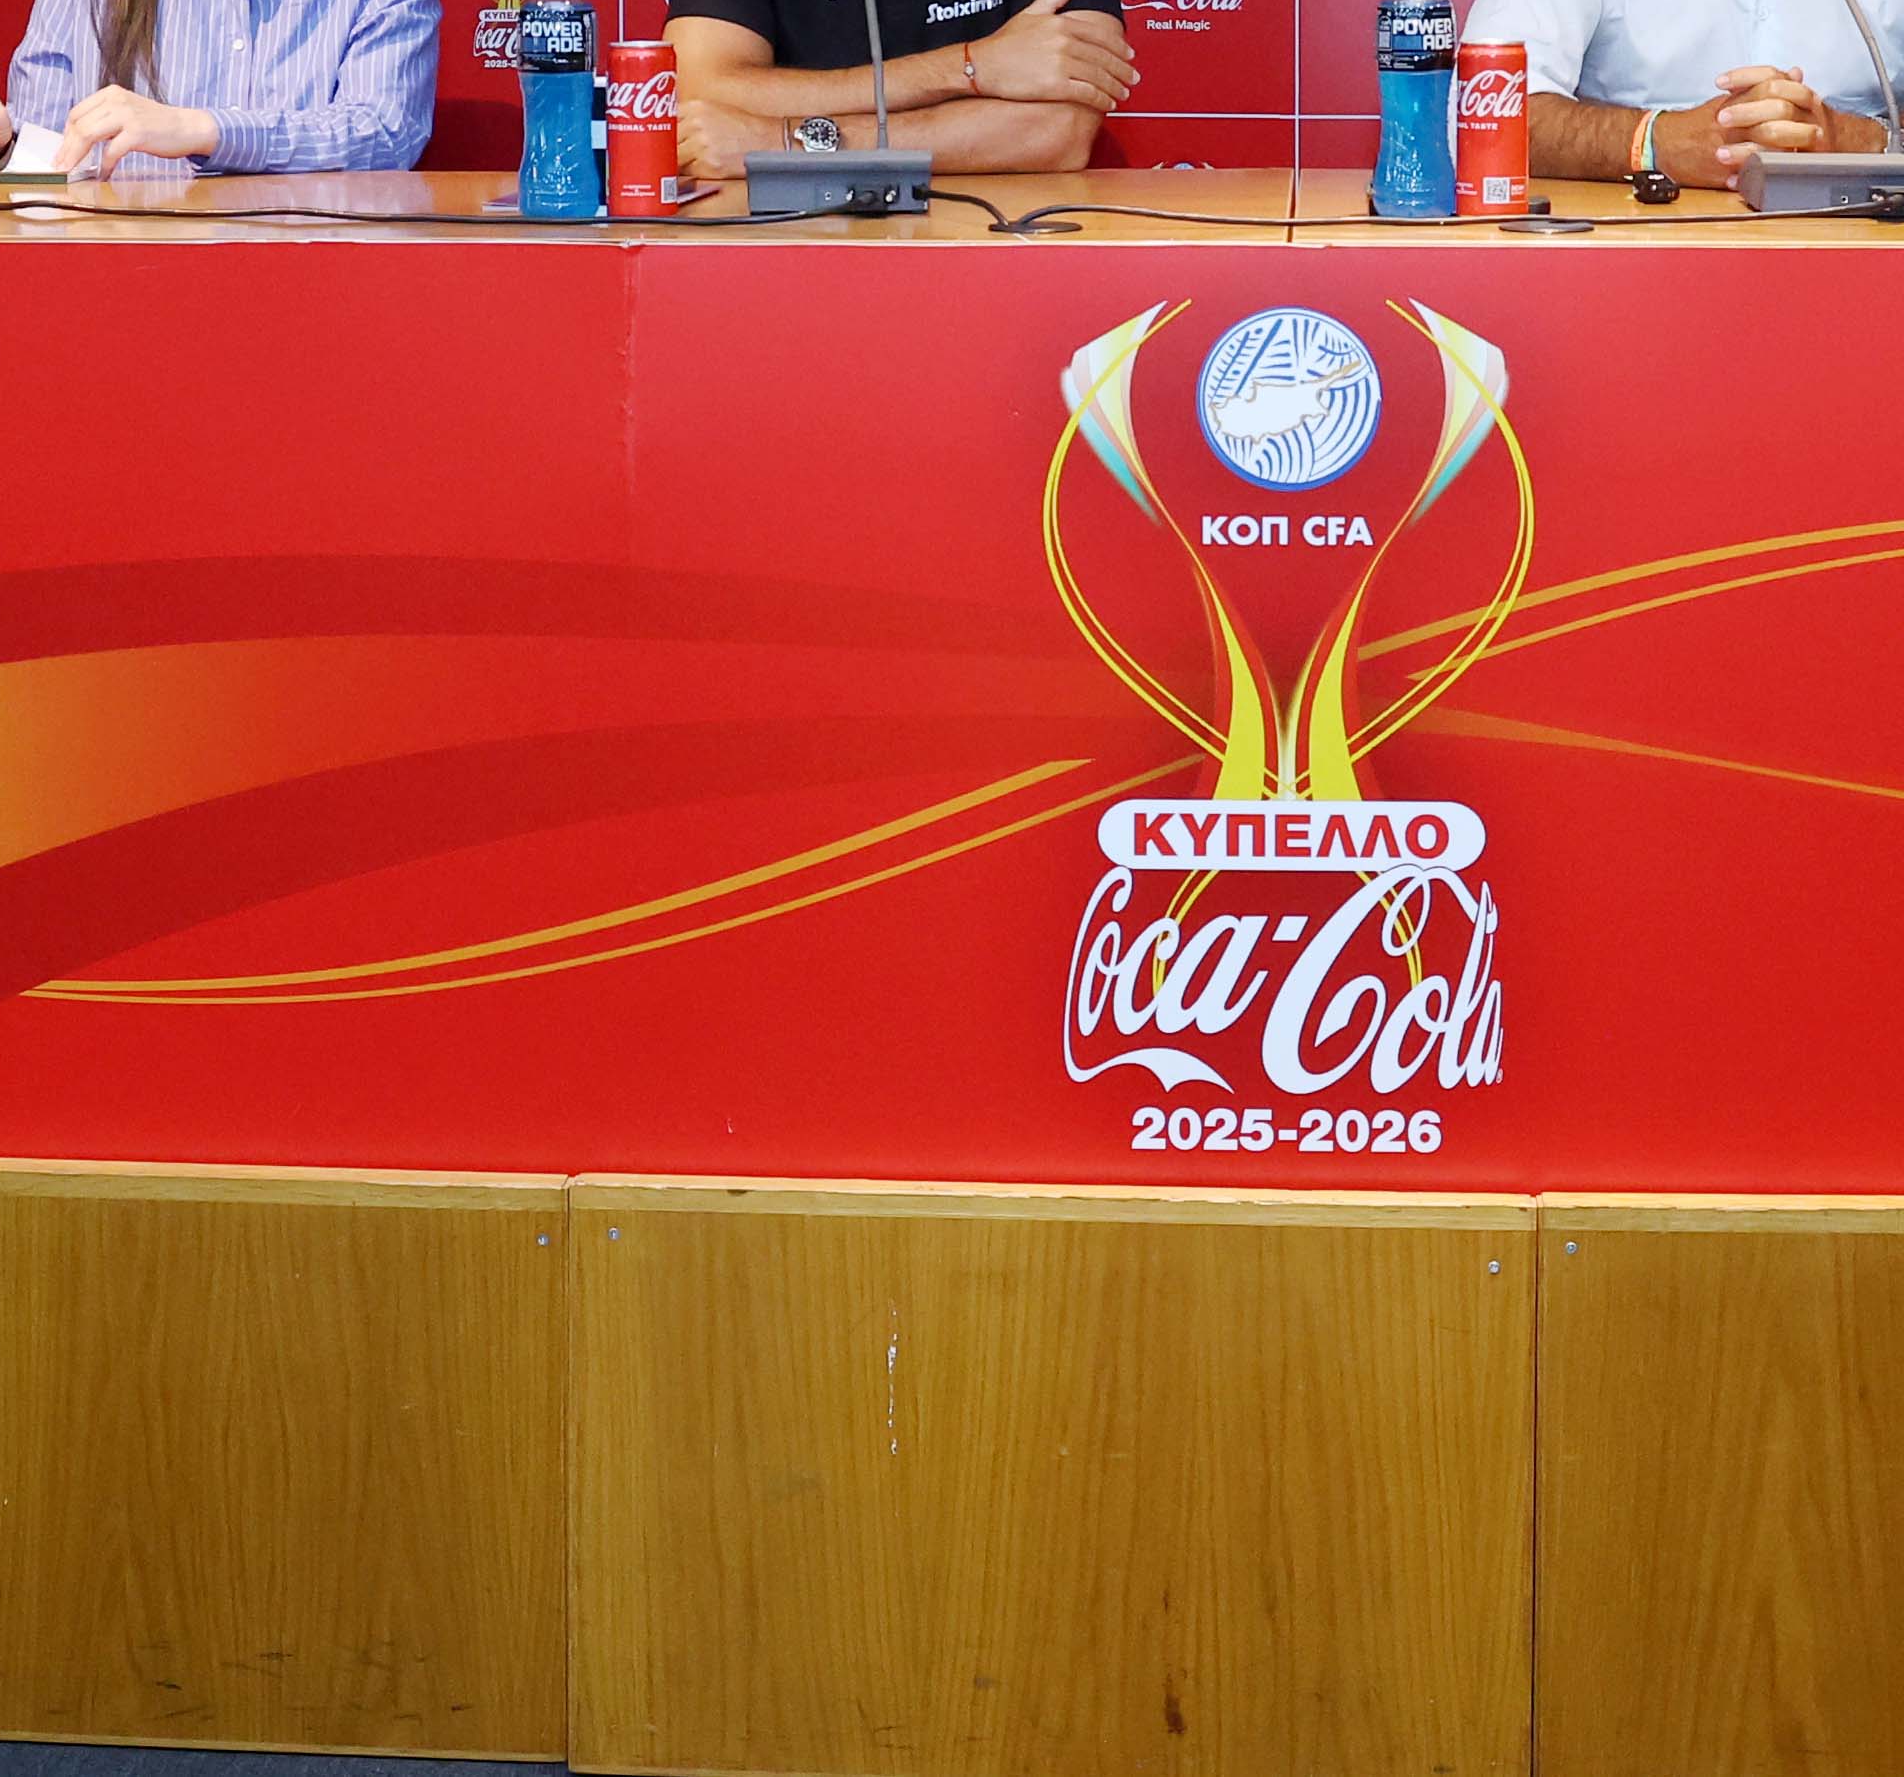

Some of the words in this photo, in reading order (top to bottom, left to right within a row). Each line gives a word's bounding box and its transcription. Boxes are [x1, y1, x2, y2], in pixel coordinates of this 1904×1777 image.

[522, 21, 583, 37] POWER
[1147, 20, 1173, 32] Real
[1176, 20, 1211, 34] Magic
[1393, 19, 1454, 36] POWER
[546, 37, 583, 53] ADE
[1423, 35, 1454, 51] ADE
[1470, 122, 1498, 131] TASTE
[1201, 515, 1289, 546] ΚΟΠ
[1302, 515, 1374, 546] CFA
[1133, 814, 1450, 858] ΚΥΠΕΛΛΟ
[1064, 864, 1503, 1094] Coca-Cola
[1131, 1107, 1443, 1152] 2025-2026
